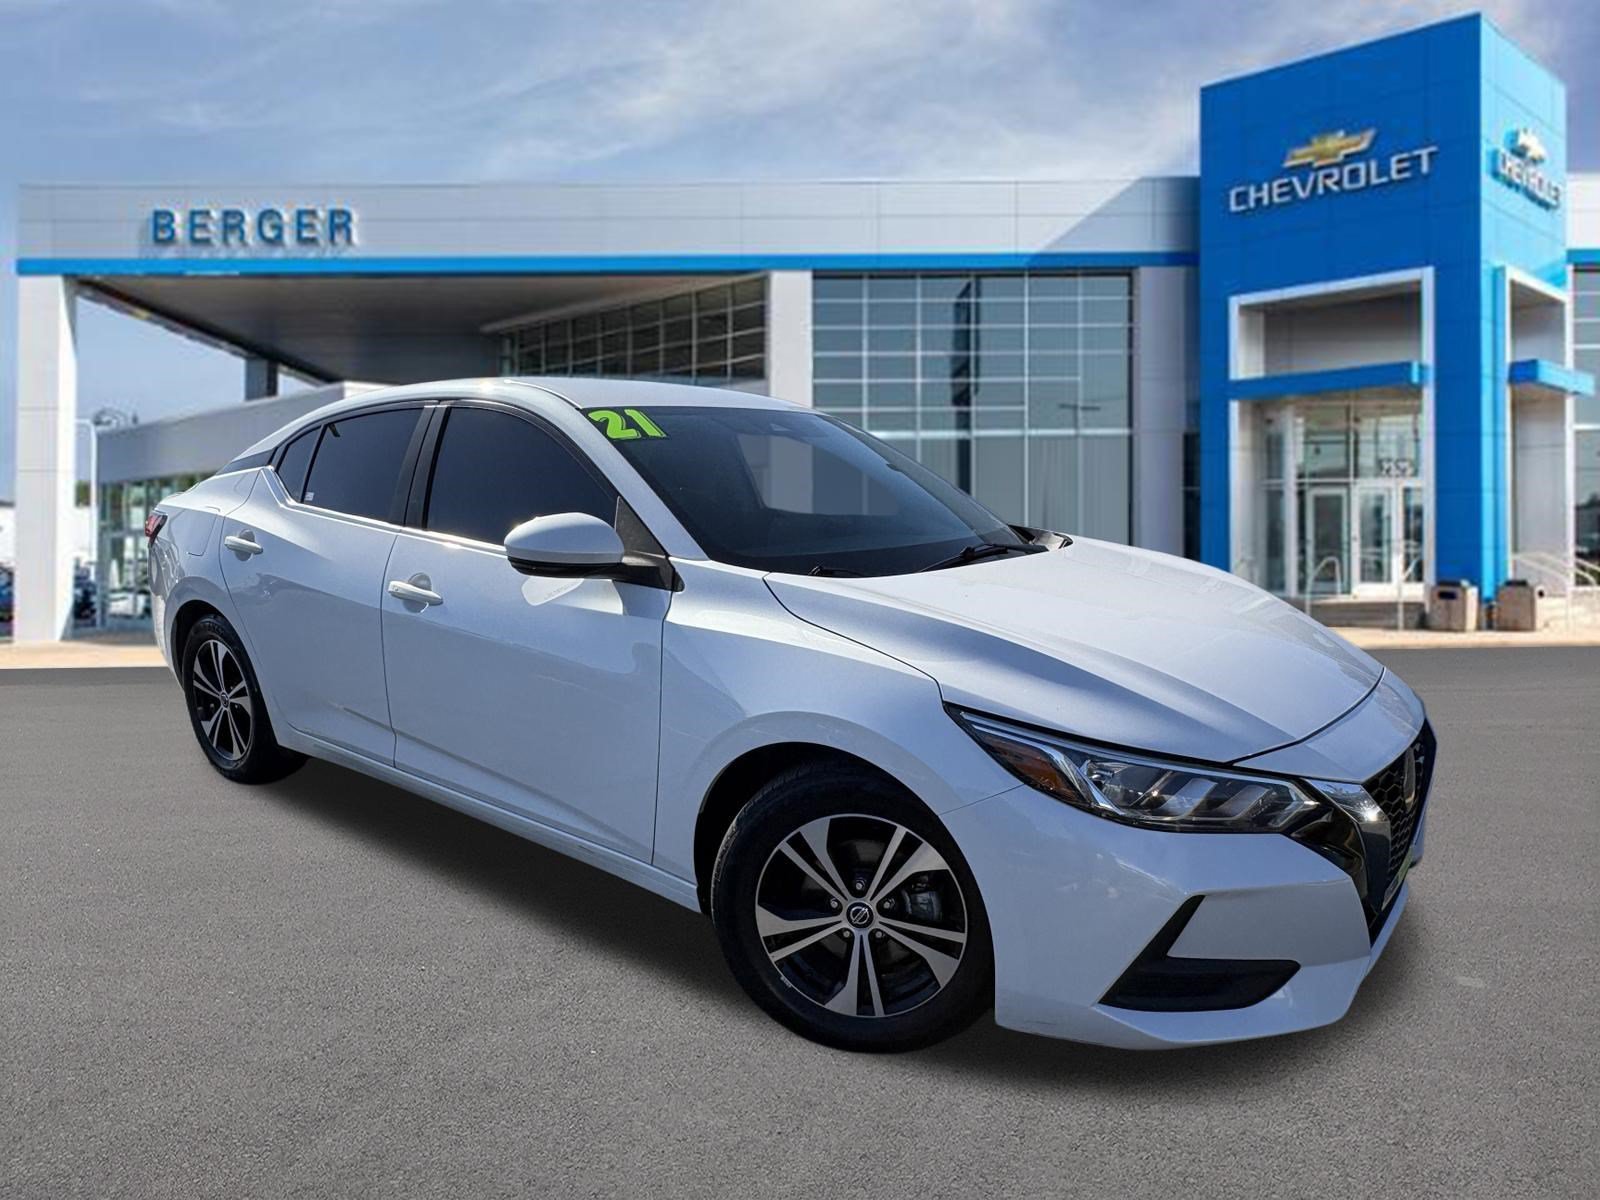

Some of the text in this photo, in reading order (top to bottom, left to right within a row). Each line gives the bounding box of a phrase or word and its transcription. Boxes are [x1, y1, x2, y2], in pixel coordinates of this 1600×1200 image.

[1229, 146, 1438, 212] CHEVROLET
[1496, 146, 1563, 208] CHEVROLE
[152, 208, 357, 247] BERGER
[588, 408, 667, 440] 21
